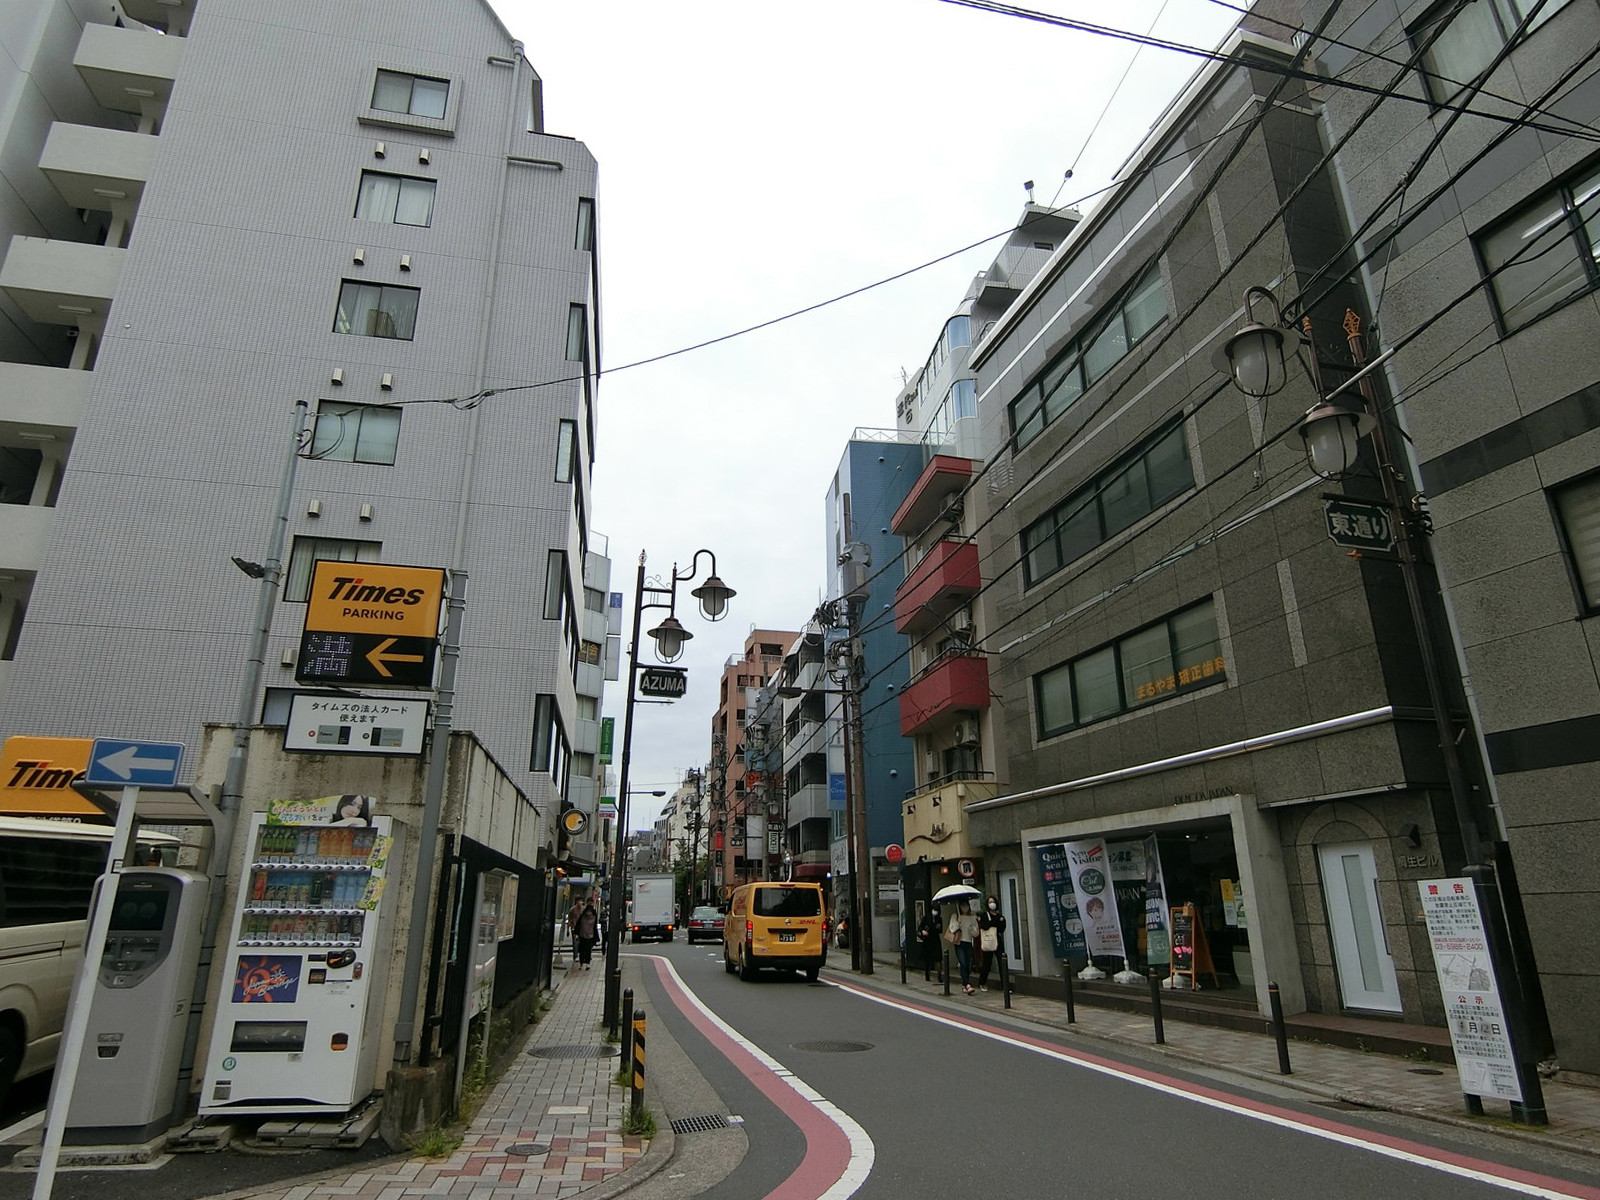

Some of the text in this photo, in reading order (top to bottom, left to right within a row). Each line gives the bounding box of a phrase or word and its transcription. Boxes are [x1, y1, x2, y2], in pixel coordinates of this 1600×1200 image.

[1329, 512, 1388, 540] 東通り
[328, 577, 425, 605] Times
[342, 607, 404, 621] PARKING
[304, 634, 352, 676] 満
[641, 675, 685, 692] AZUMA
[312, 702, 408, 714] タイムズの法人カード
[340, 714, 377, 724] 使えます
[1458, 995, 1484, 1005] 公示
